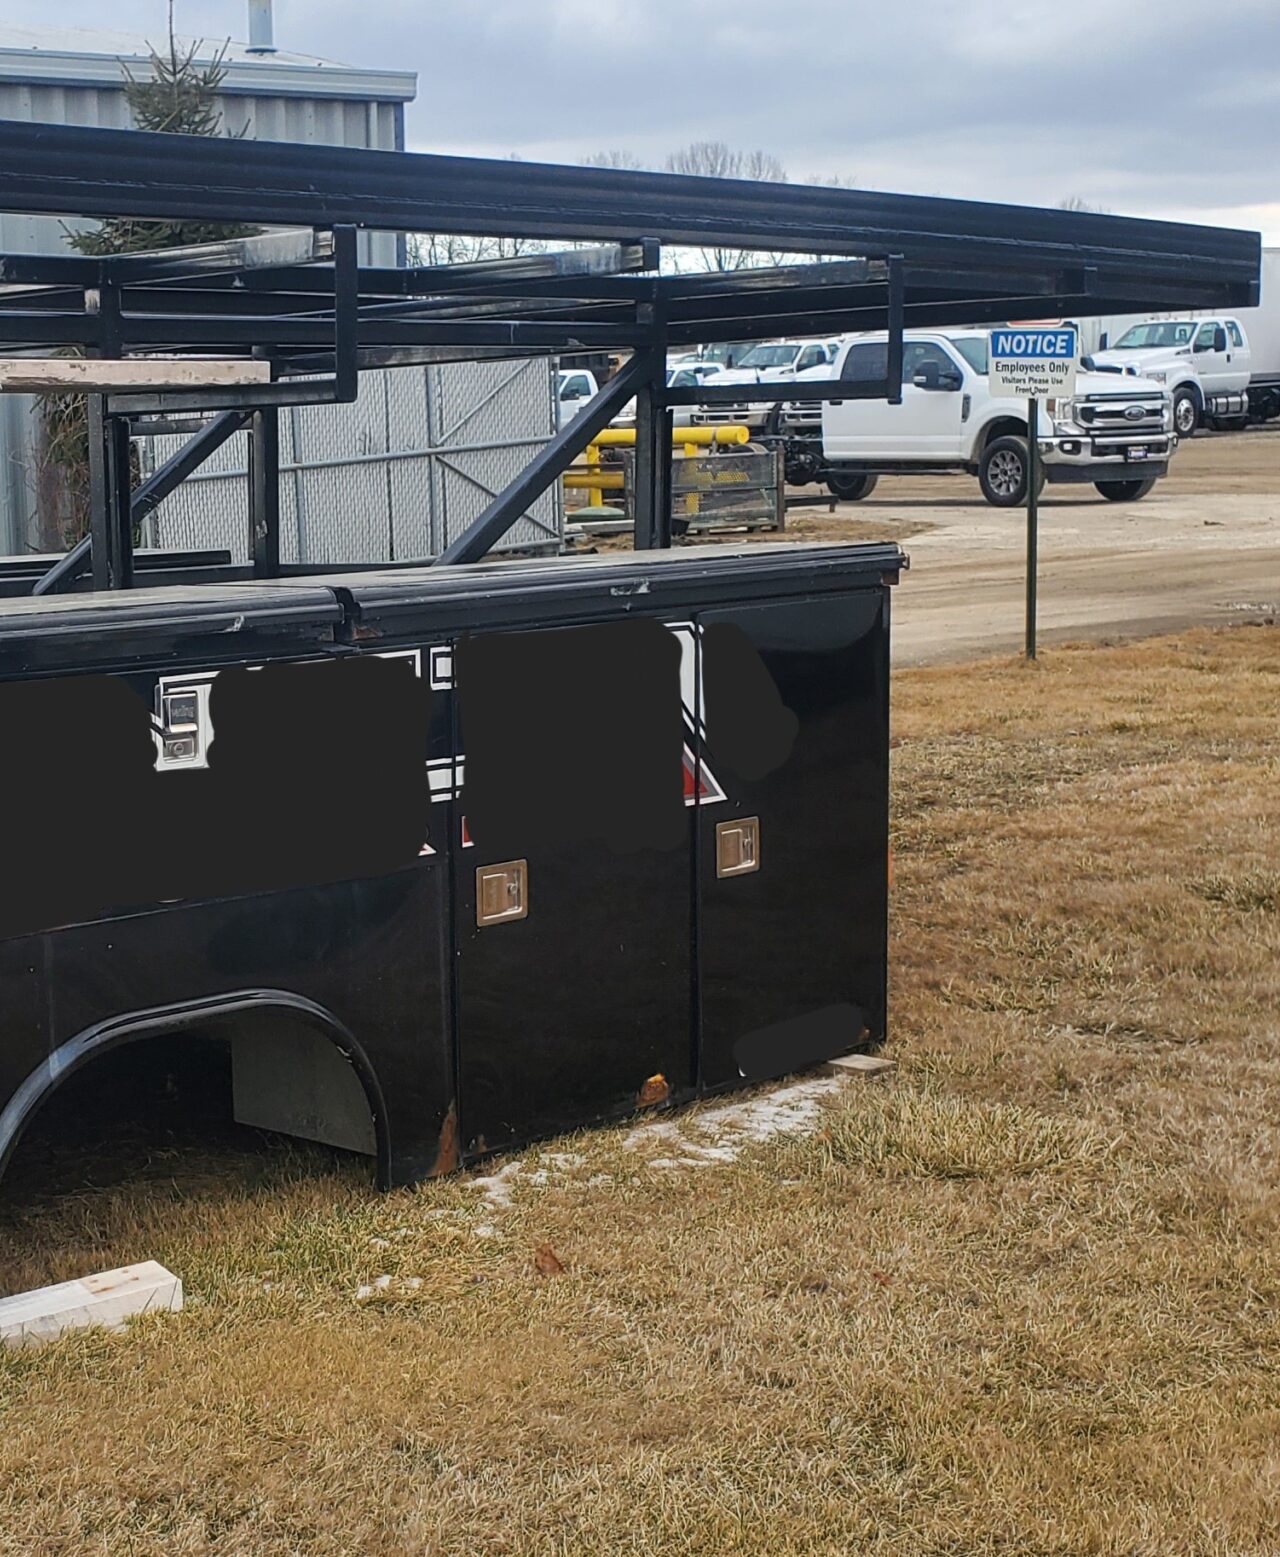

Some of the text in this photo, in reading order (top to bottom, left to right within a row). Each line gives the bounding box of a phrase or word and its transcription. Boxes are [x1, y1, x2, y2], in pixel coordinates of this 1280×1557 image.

[997, 335, 1069, 354] NOTICE
[995, 361, 1070, 375] Employees Only
[1001, 376, 1063, 385] Visitors Please Use
